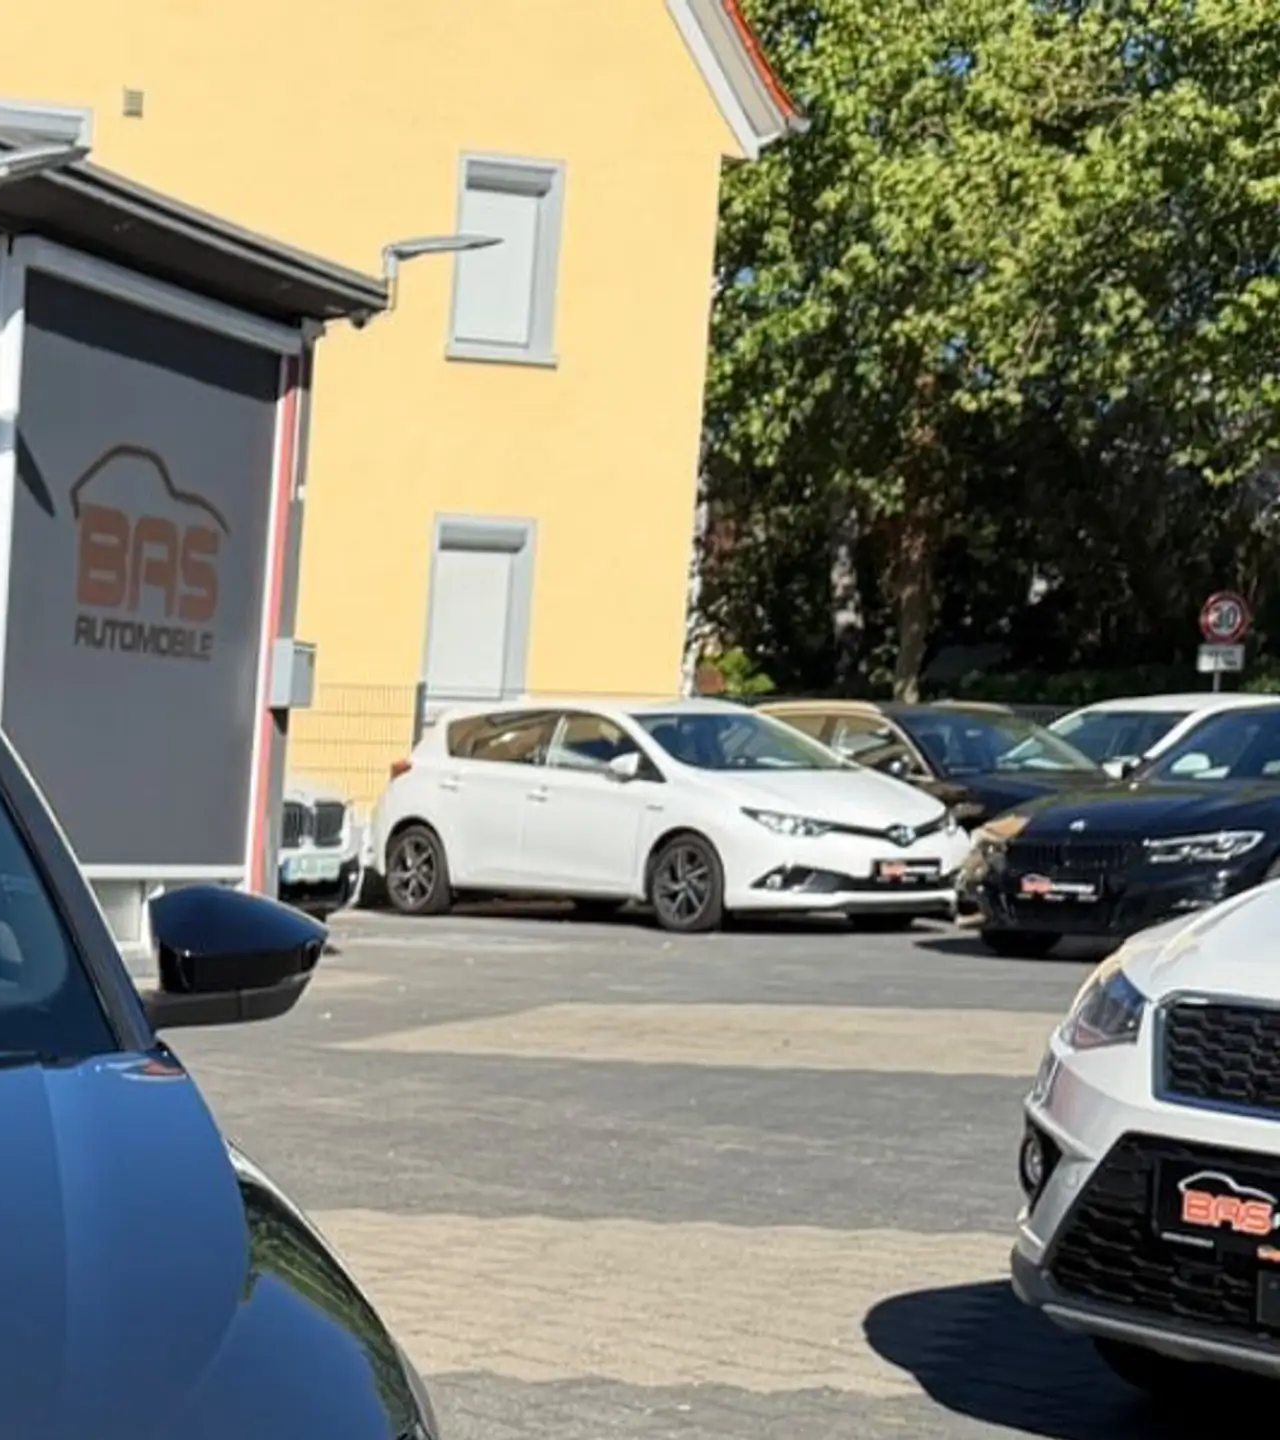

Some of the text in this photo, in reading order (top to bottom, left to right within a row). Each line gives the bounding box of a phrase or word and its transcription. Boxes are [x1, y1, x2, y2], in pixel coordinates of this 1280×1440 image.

[76, 503, 219, 622] BAS
[74, 616, 214, 661] AUTOMOBILE
[1212, 605, 1238, 629] 30
[1183, 1191, 1272, 1235] BAS
